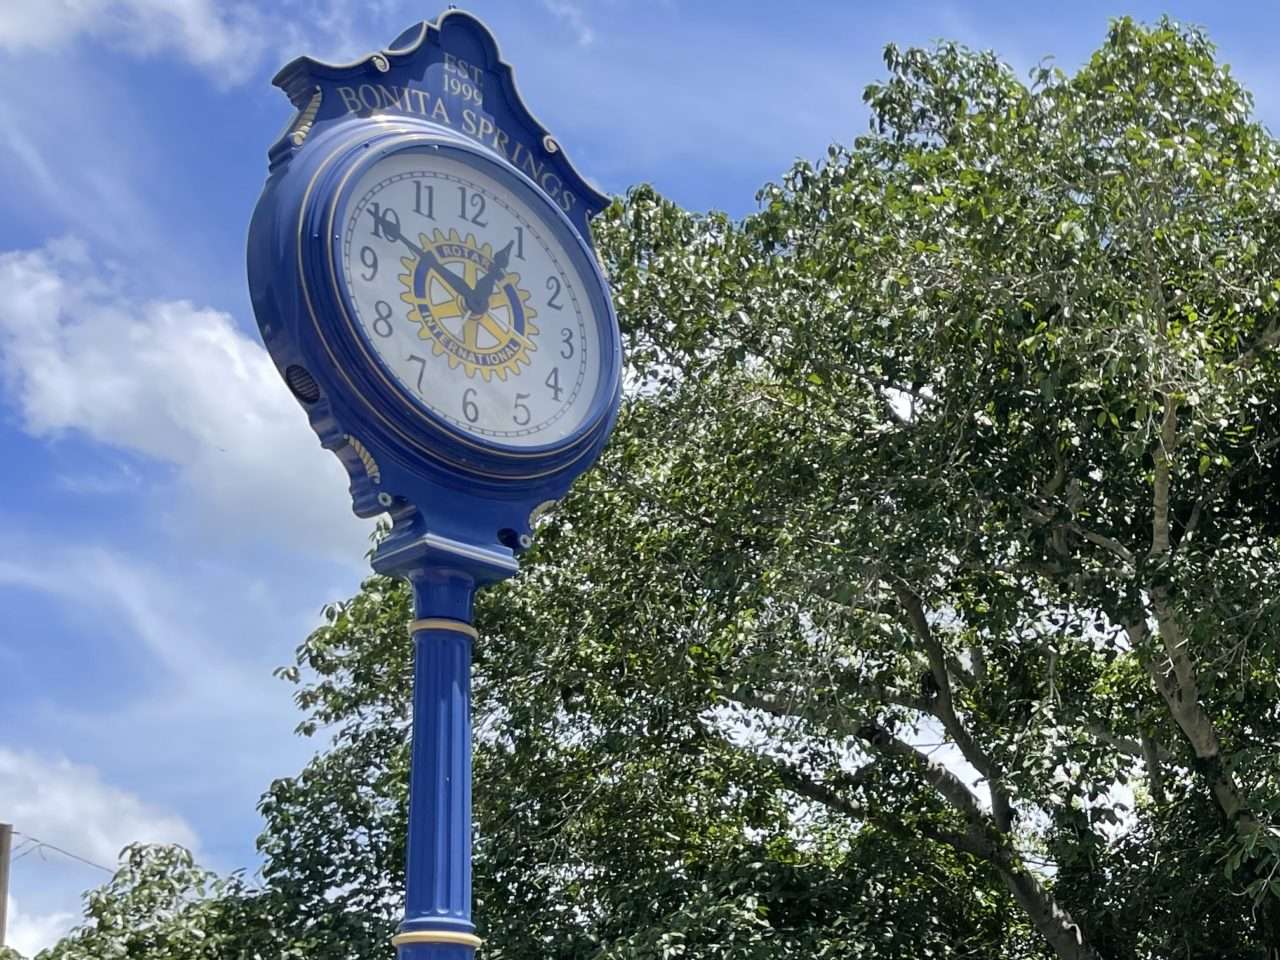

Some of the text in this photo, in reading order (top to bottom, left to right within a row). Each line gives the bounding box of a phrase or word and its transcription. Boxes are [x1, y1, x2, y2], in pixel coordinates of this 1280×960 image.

[443, 73, 483, 106] 1999
[337, 84, 577, 212] BONITA SPRINGS
[412, 180, 437, 221] 11
[458, 186, 489, 228] 12
[370, 202, 401, 243] 10
[443, 245, 489, 271] ROTAR
[514, 226, 527, 261] 1
[360, 246, 379, 282] 9
[546, 276, 563, 310] 2
[372, 300, 393, 338] 8
[421, 311, 517, 365] INTERNATIONAL
[559, 328, 574, 360] 3
[407, 354, 426, 394] 7
[545, 367, 564, 402] 4
[462, 388, 479, 423] 6
[513, 393, 531, 426] 5
